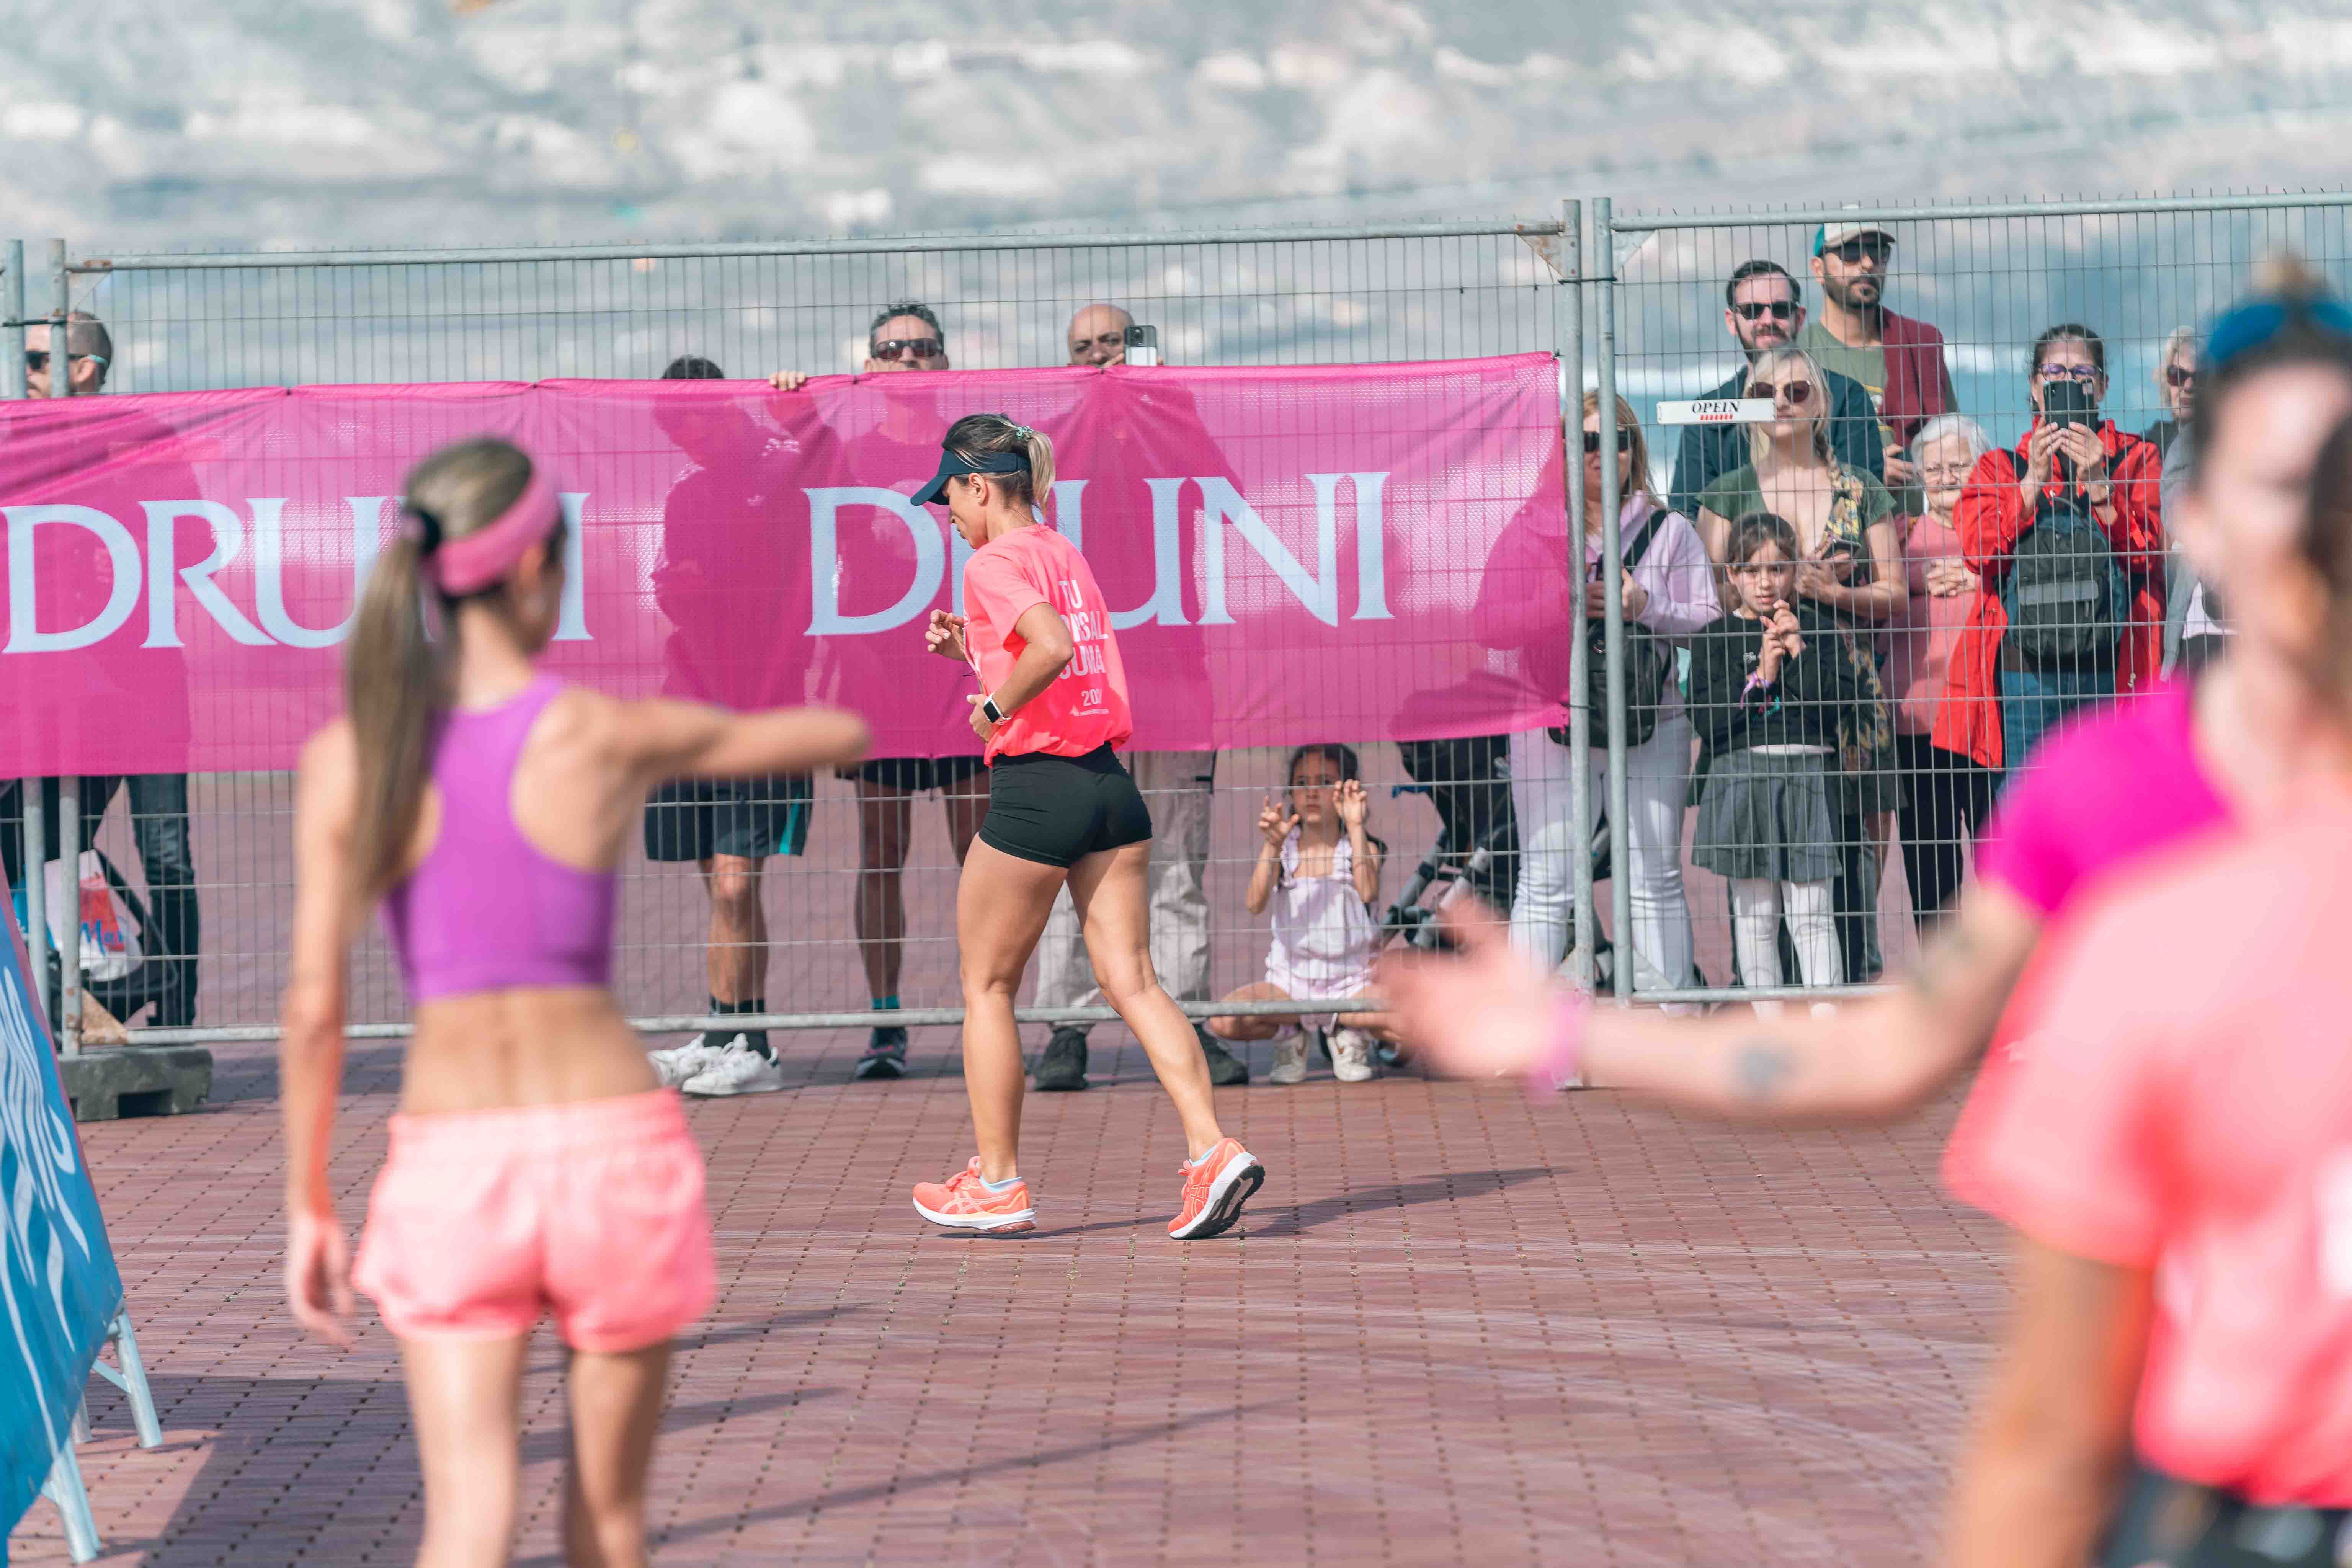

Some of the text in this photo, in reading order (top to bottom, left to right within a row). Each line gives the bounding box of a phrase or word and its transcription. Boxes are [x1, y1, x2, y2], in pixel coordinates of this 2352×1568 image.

[1692, 402, 1739, 413] OPEIN
[2, 492, 594, 653] DRUI
[1059, 580, 1083, 609] TU
